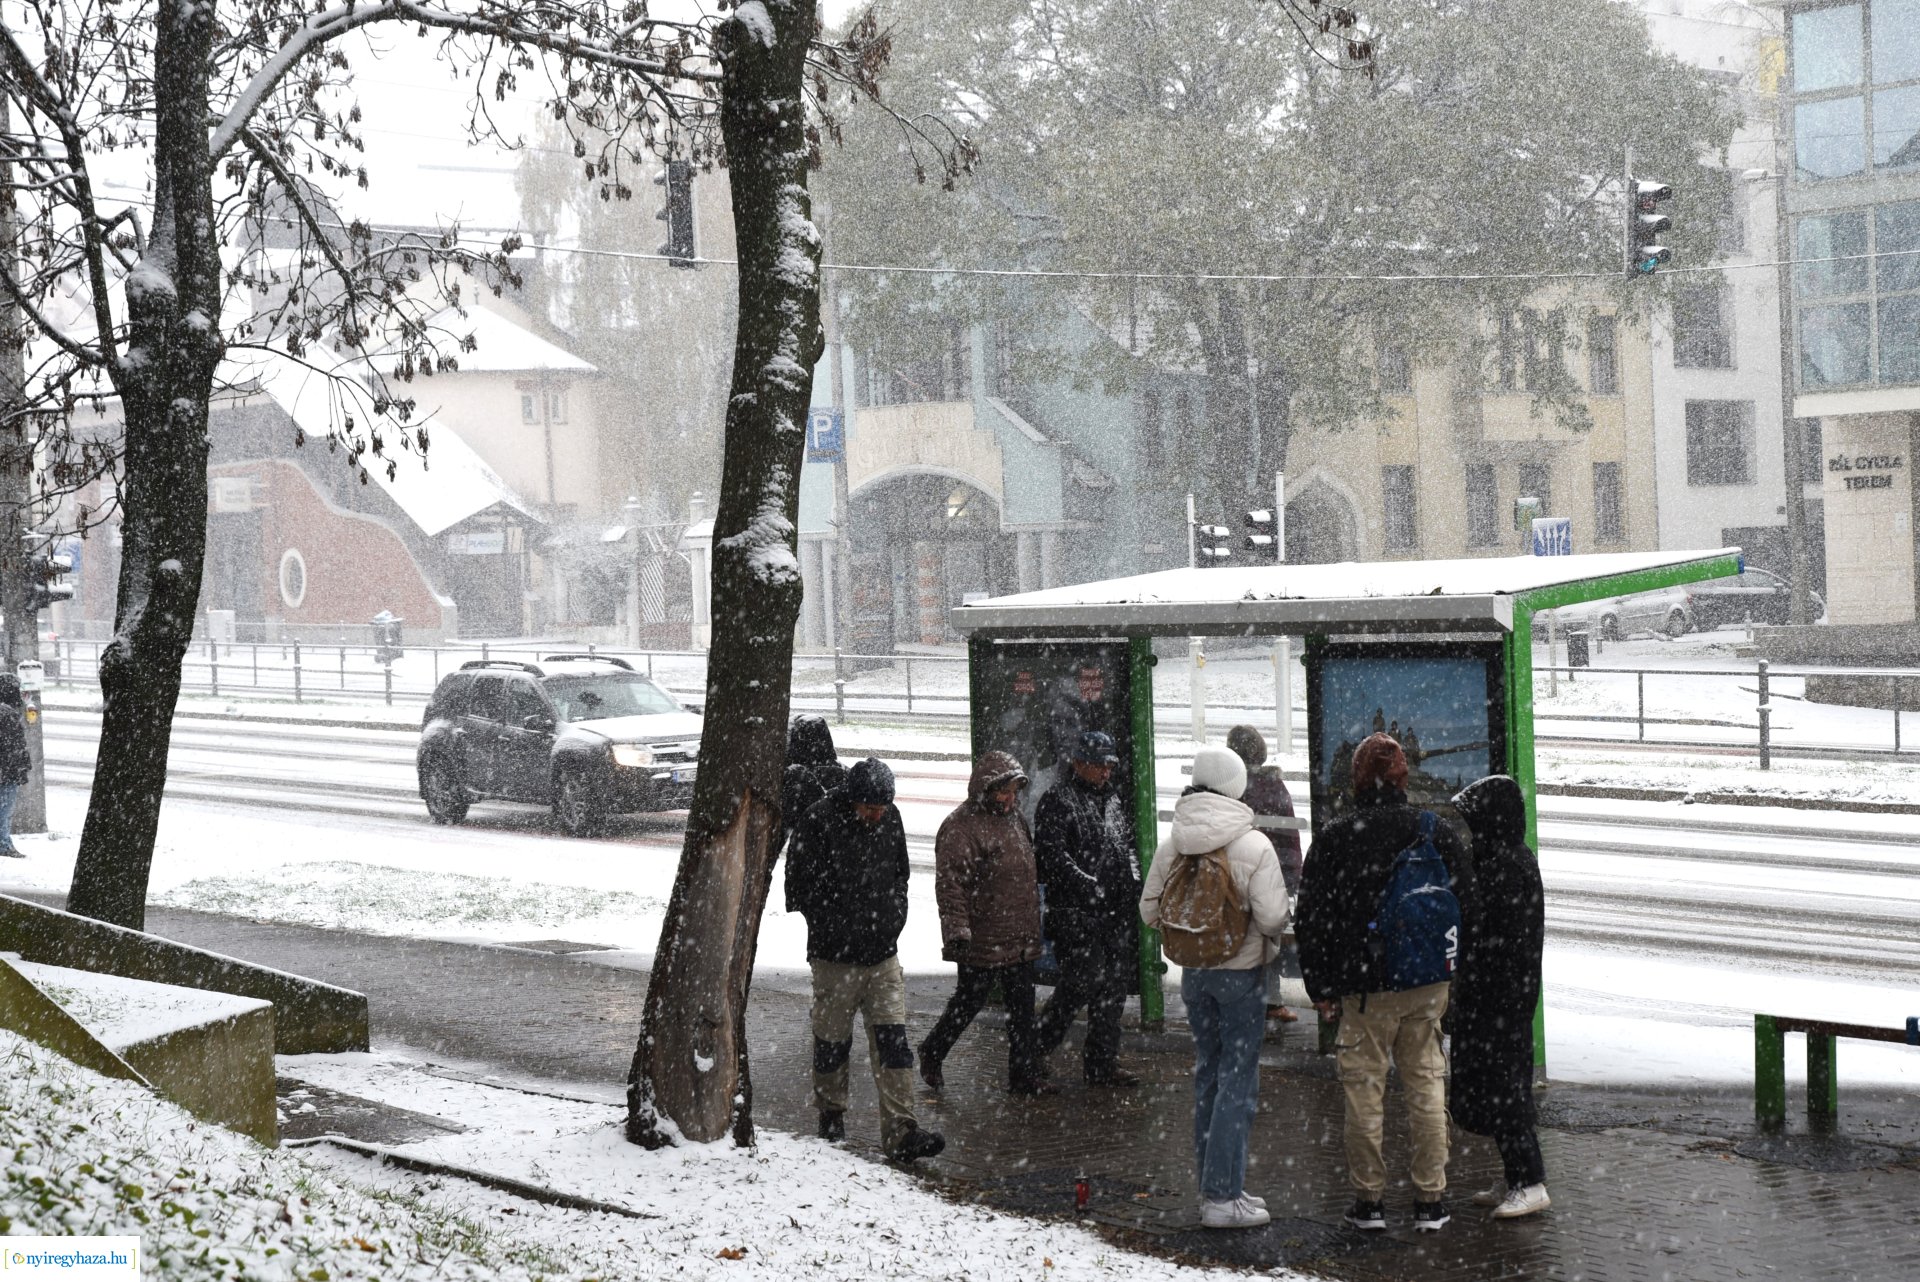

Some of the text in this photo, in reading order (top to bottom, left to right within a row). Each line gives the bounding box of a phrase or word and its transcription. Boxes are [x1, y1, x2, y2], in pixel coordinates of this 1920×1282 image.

[813, 415, 833, 449] P
[1844, 475, 1892, 490] TEREM
[1444, 925, 1458, 972] FILA
